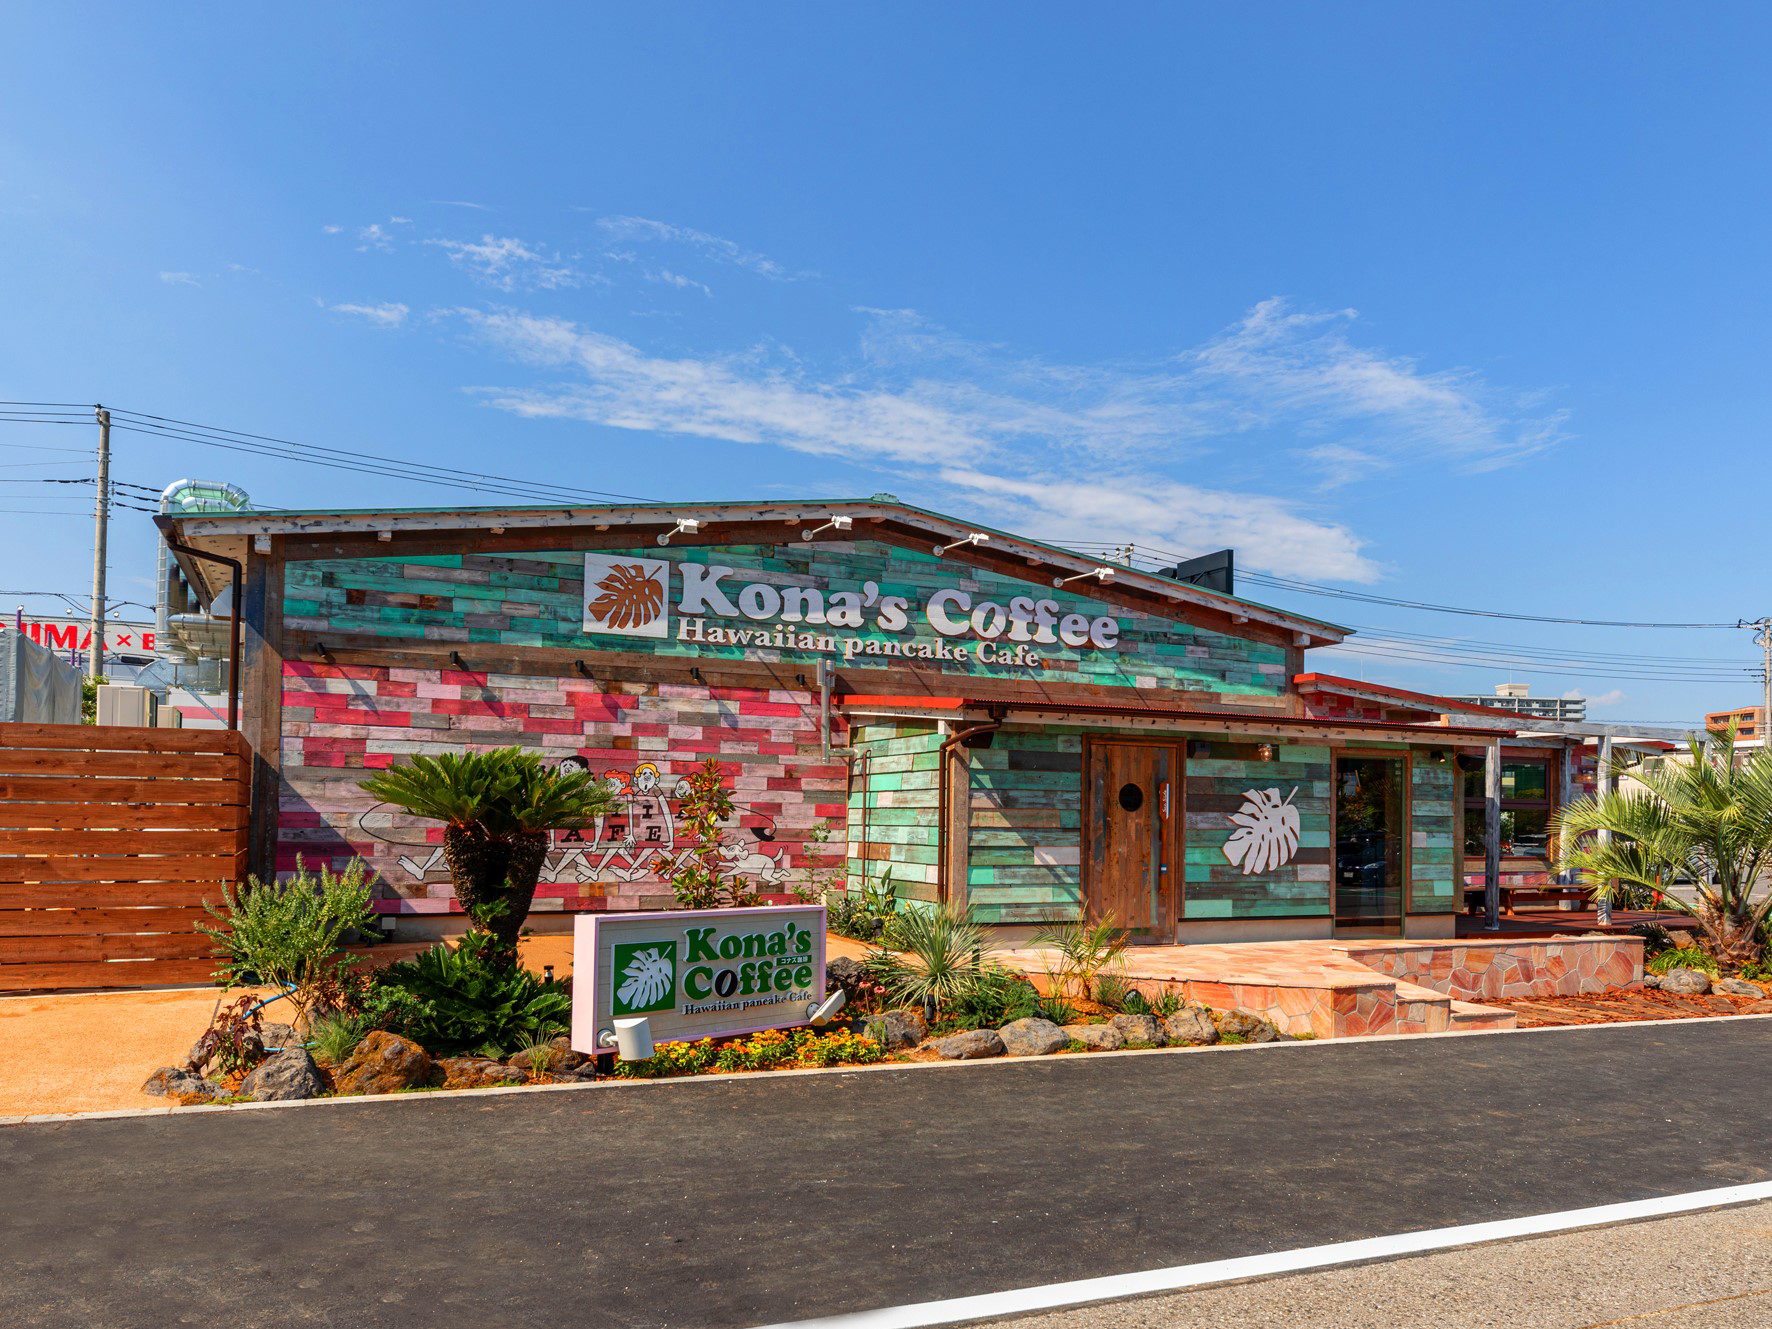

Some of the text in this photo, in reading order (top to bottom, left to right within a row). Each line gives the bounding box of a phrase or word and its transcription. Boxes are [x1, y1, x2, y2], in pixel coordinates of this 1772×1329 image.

[677, 563, 1119, 649] Kona's Coffee
[676, 617, 1040, 667] Hawaiian pancake Cafe
[683, 922, 811, 962] Kona's
[682, 960, 813, 1000] Coffee
[683, 989, 812, 1015] Hawaiian pancake Cafe
